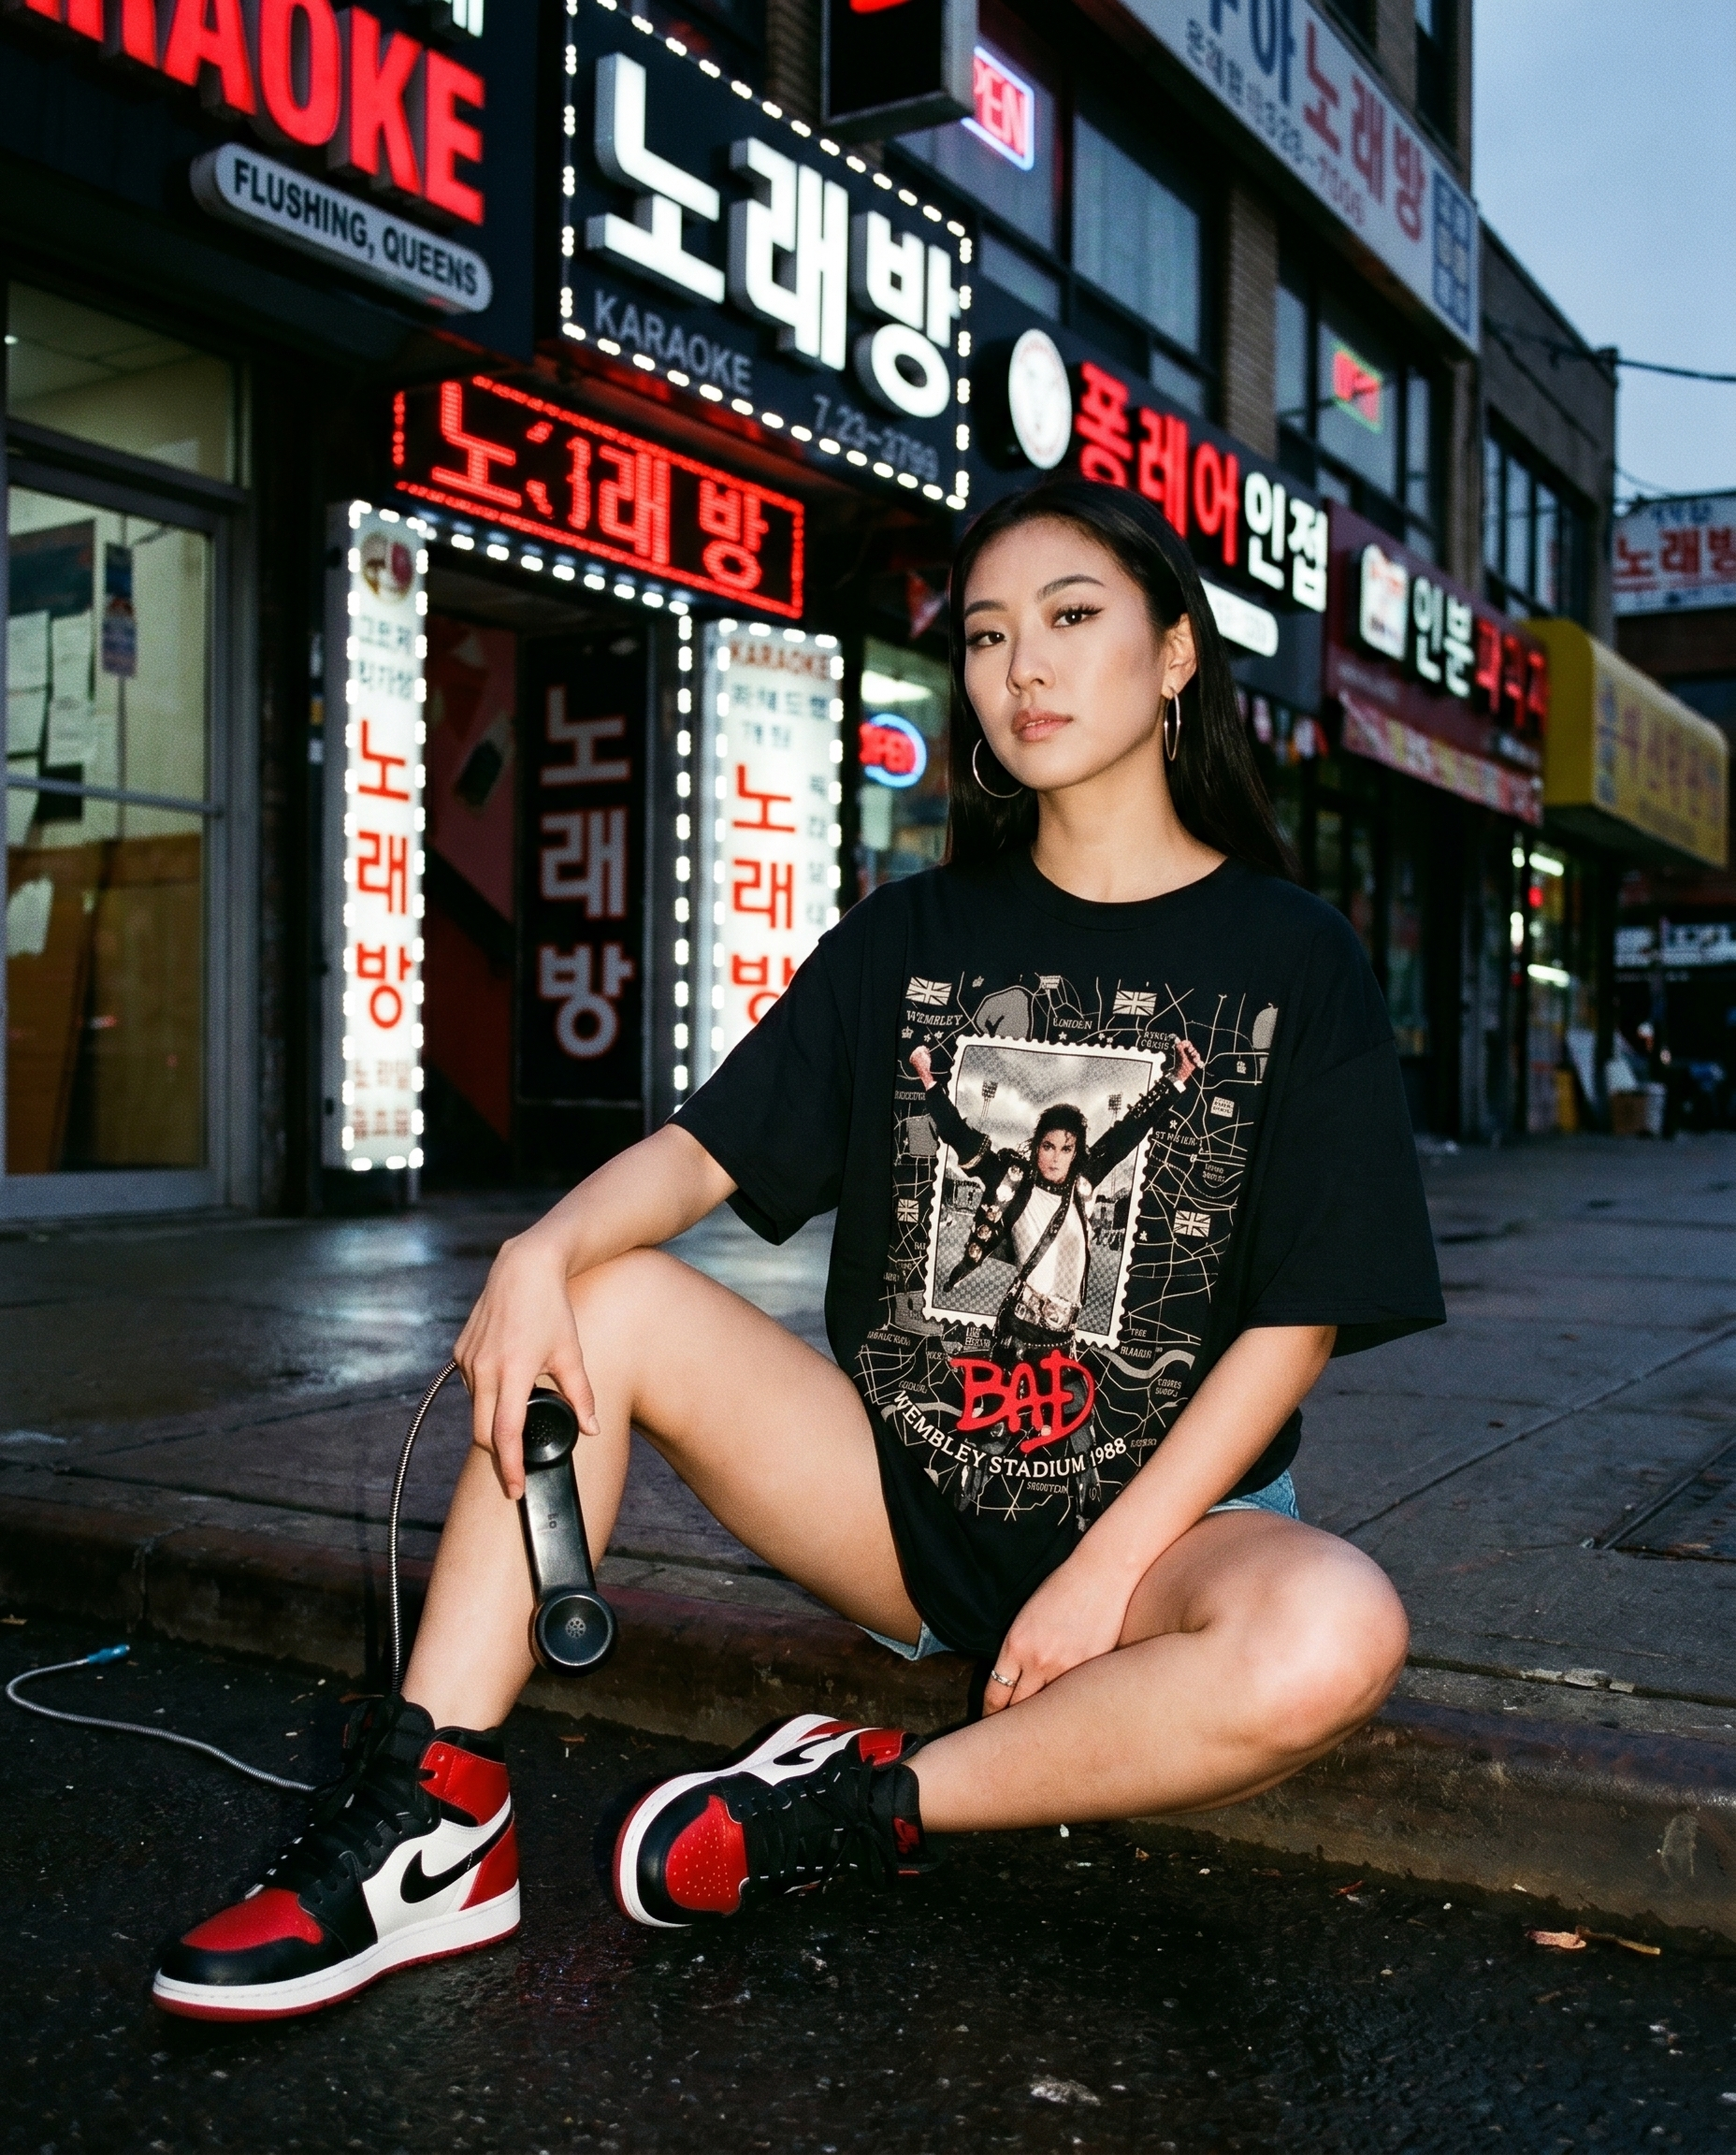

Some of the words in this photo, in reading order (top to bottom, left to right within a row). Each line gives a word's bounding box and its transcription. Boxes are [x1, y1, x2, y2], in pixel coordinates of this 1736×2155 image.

[233, 158, 375, 258] FLUSHING,
[383, 226, 478, 296] QUEENS
[599, 52, 962, 419] 노래방
[594, 289, 752, 396] KARAOKE
[357, 719, 412, 1029] 노래방
[540, 686, 635, 1058] 노래방
[731, 763, 796, 1024] 노래방
[893, 1390, 987, 1468] WEMBLEY
[989, 1455, 1086, 1478] STADIUM
[1089, 1437, 1127, 1468] 1988
[949, 1349, 1095, 1454] BAD
